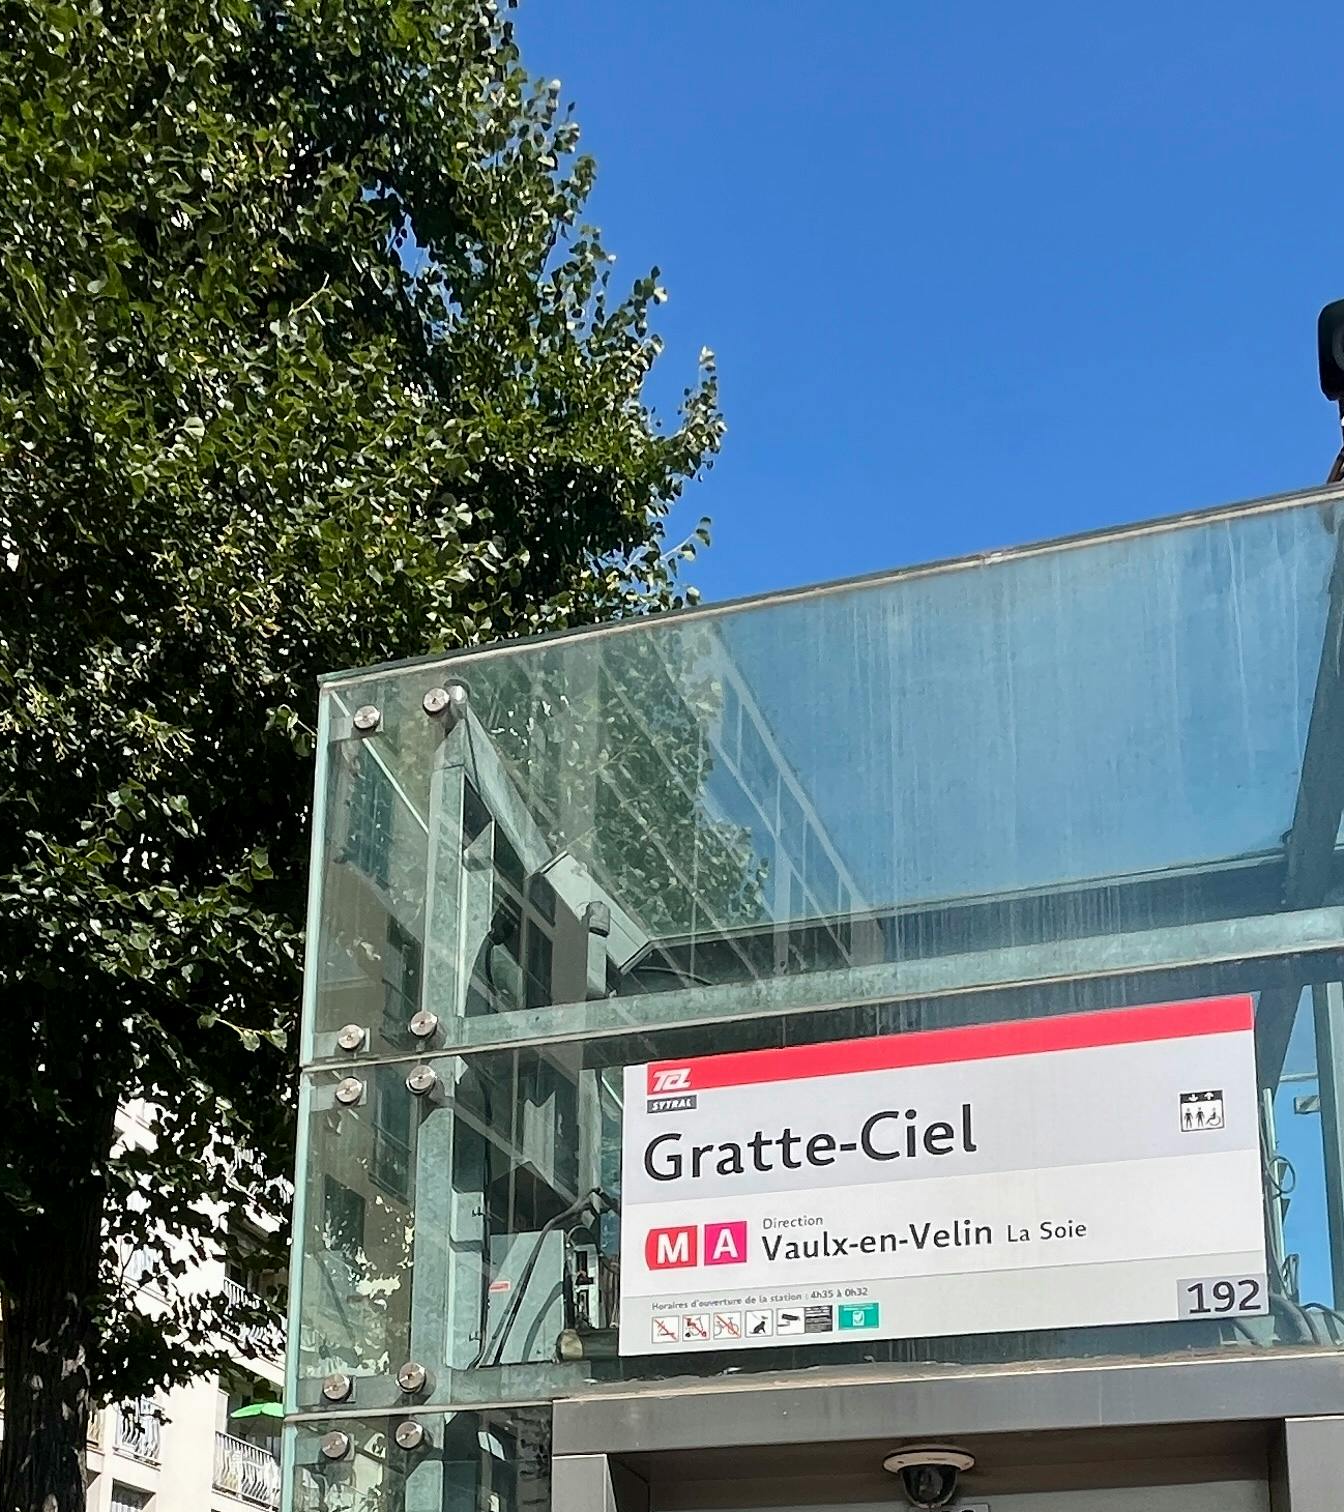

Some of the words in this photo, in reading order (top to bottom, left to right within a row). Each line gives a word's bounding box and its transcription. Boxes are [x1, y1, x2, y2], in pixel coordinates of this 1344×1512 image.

[653, 1067, 692, 1092] TCL
[652, 1098, 692, 1111] SYTRAL
[644, 1103, 977, 1181] Gratte-Ciel
[762, 1215, 824, 1230] Direction
[657, 1232, 689, 1264] M
[712, 1227, 739, 1260] A
[761, 1219, 992, 1261] Vaulx-en-Velin
[1007, 1224, 1030, 1243] La
[1040, 1220, 1087, 1241] Soie
[651, 1301, 688, 1310] Horaires
[691, 1298, 742, 1308] d'ouverture
[745, 1296, 756, 1304] de
[759, 1295, 768, 1303] la
[770, 1293, 802, 1302] station
[810, 1289, 834, 1299] 4h35
[836, 1289, 842, 1298] à
[844, 1287, 868, 1297] 0h32
[1187, 1279, 1261, 1314] 192
